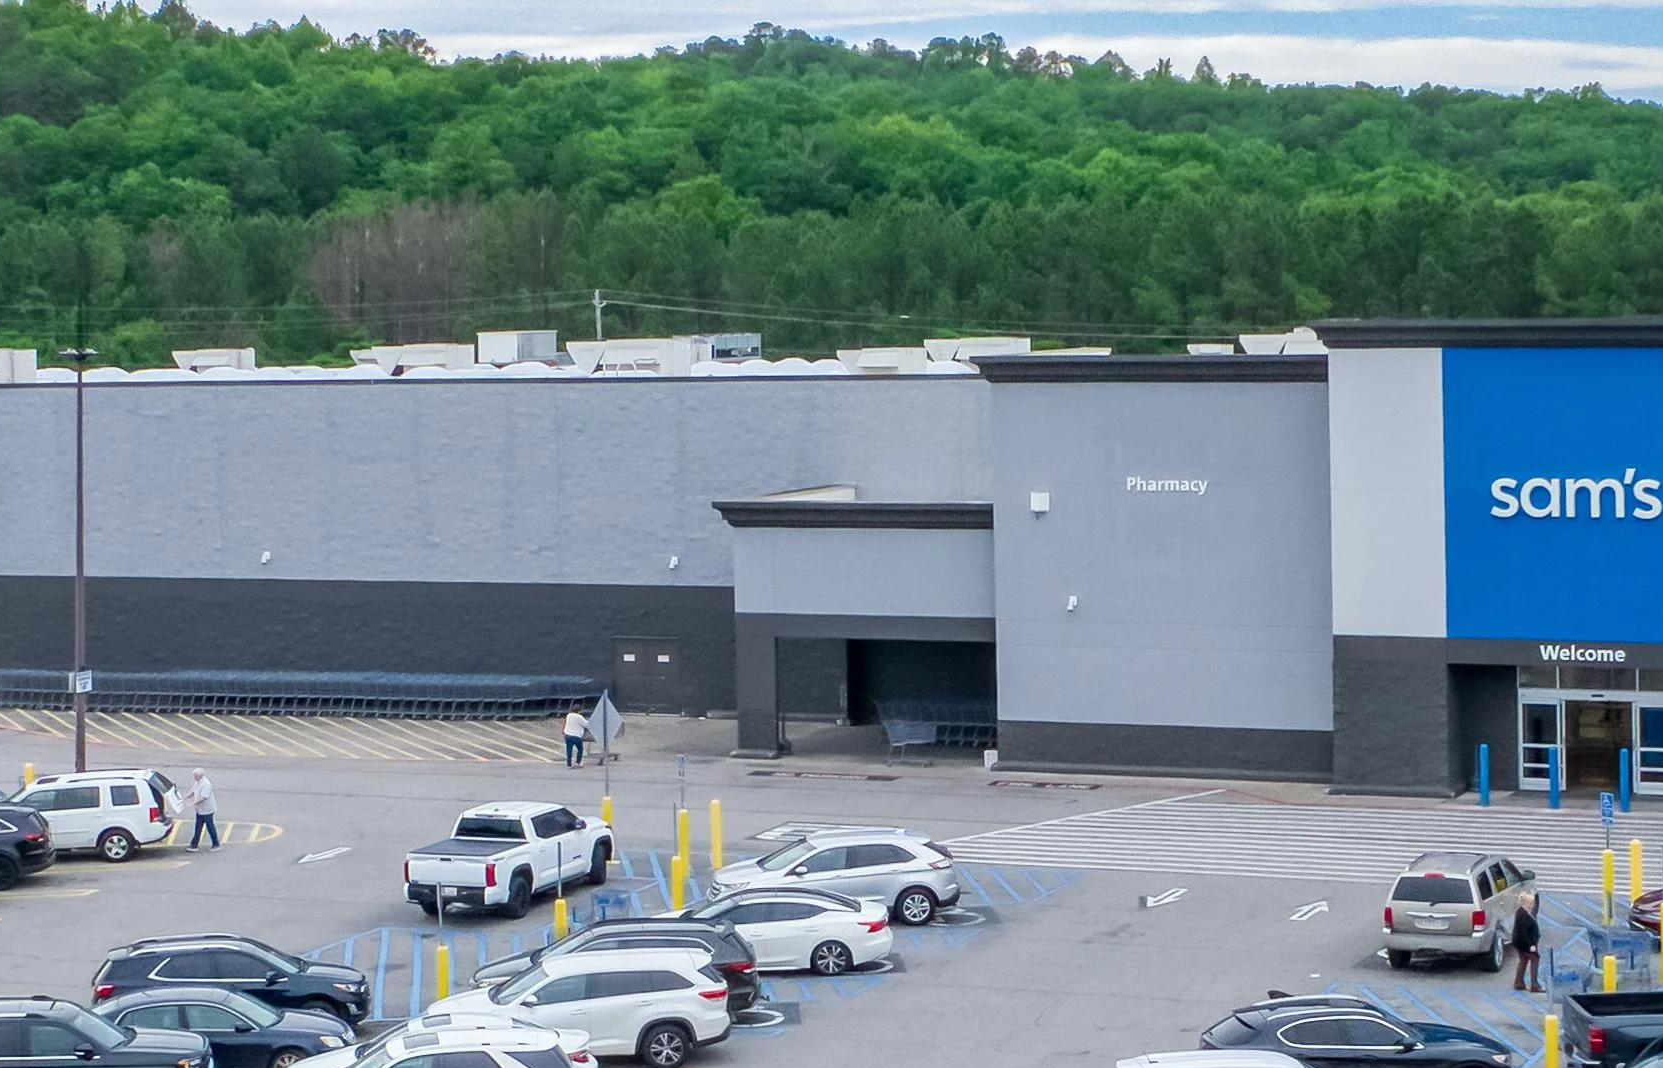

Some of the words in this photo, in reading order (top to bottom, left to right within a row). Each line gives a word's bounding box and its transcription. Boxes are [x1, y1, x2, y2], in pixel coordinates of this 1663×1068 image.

[1126, 476, 1208, 496] Pharmacy
[1490, 467, 1663, 520] sam's
[1539, 644, 1627, 663] Welcome
